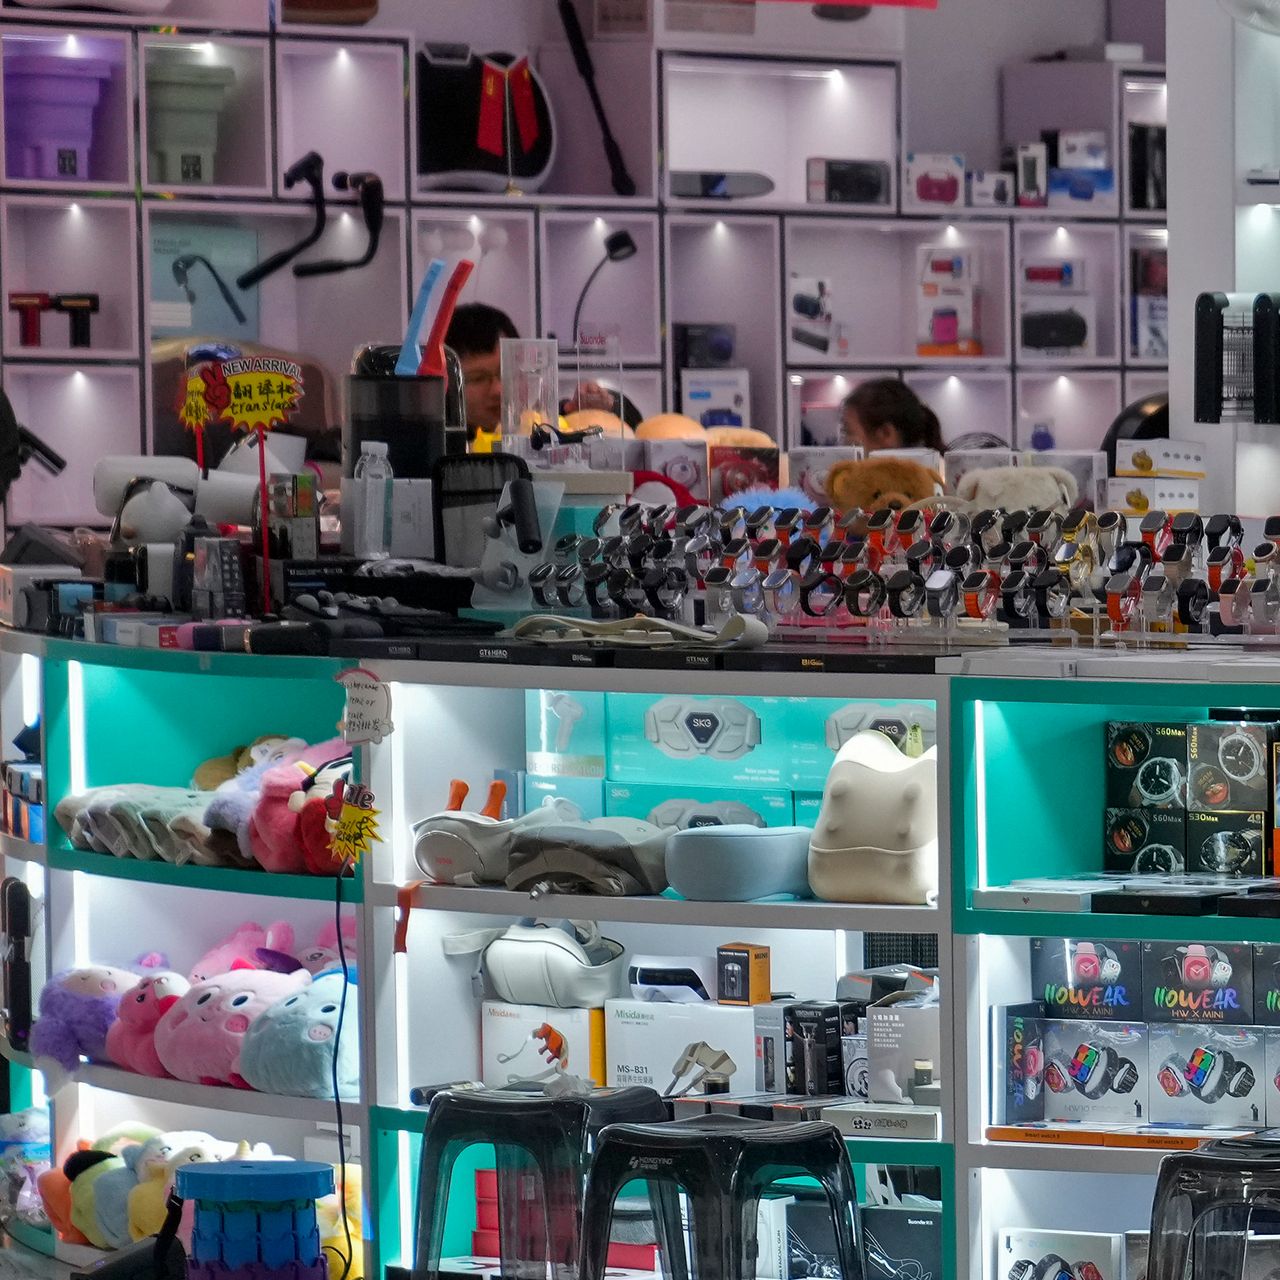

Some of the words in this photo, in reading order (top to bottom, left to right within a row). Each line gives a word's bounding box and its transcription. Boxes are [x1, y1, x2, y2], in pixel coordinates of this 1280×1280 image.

[222, 359, 252, 377] NEW
[252, 358, 303, 383] ARRIVAL
[692, 718, 712, 728] SKG
[878, 725, 899, 735] SKG
[345, 784, 375, 809] ale
[1154, 986, 1241, 1010] HOWEAR
[488, 1008, 509, 1018] Misida
[614, 1009, 642, 1020] Misida
[1171, 1009, 1190, 1018] HW
[1192, 1010, 1200, 1018] X
[1202, 1010, 1224, 1019] MINI
[617, 1064, 649, 1074] MS-B31
